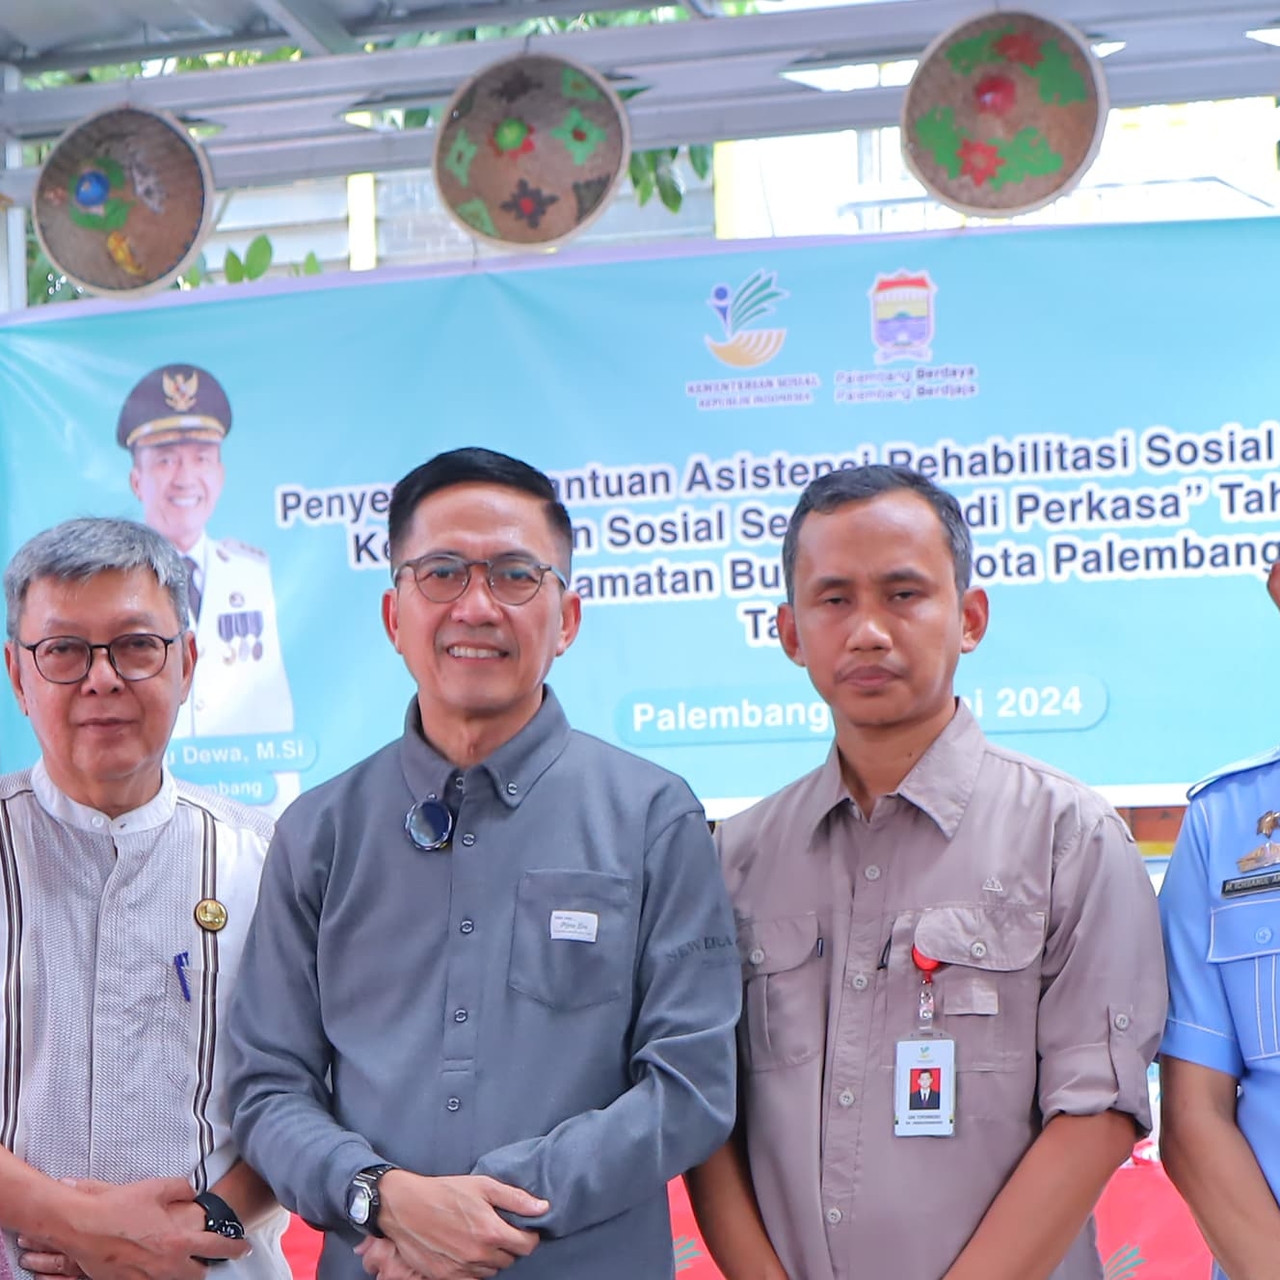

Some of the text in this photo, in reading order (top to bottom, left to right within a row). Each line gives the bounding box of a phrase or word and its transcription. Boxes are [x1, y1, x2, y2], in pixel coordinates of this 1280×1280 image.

[1146, 429, 1274, 466] Sosial
[608, 509, 725, 547] Sosial
[633, 697, 829, 732] Palembang
[996, 686, 1083, 718] 2024
[183, 746, 250, 766] Dewa,
[256, 740, 304, 760] M.Si
[665, 939, 701, 963] NEW
[703, 935, 734, 949] ERA
